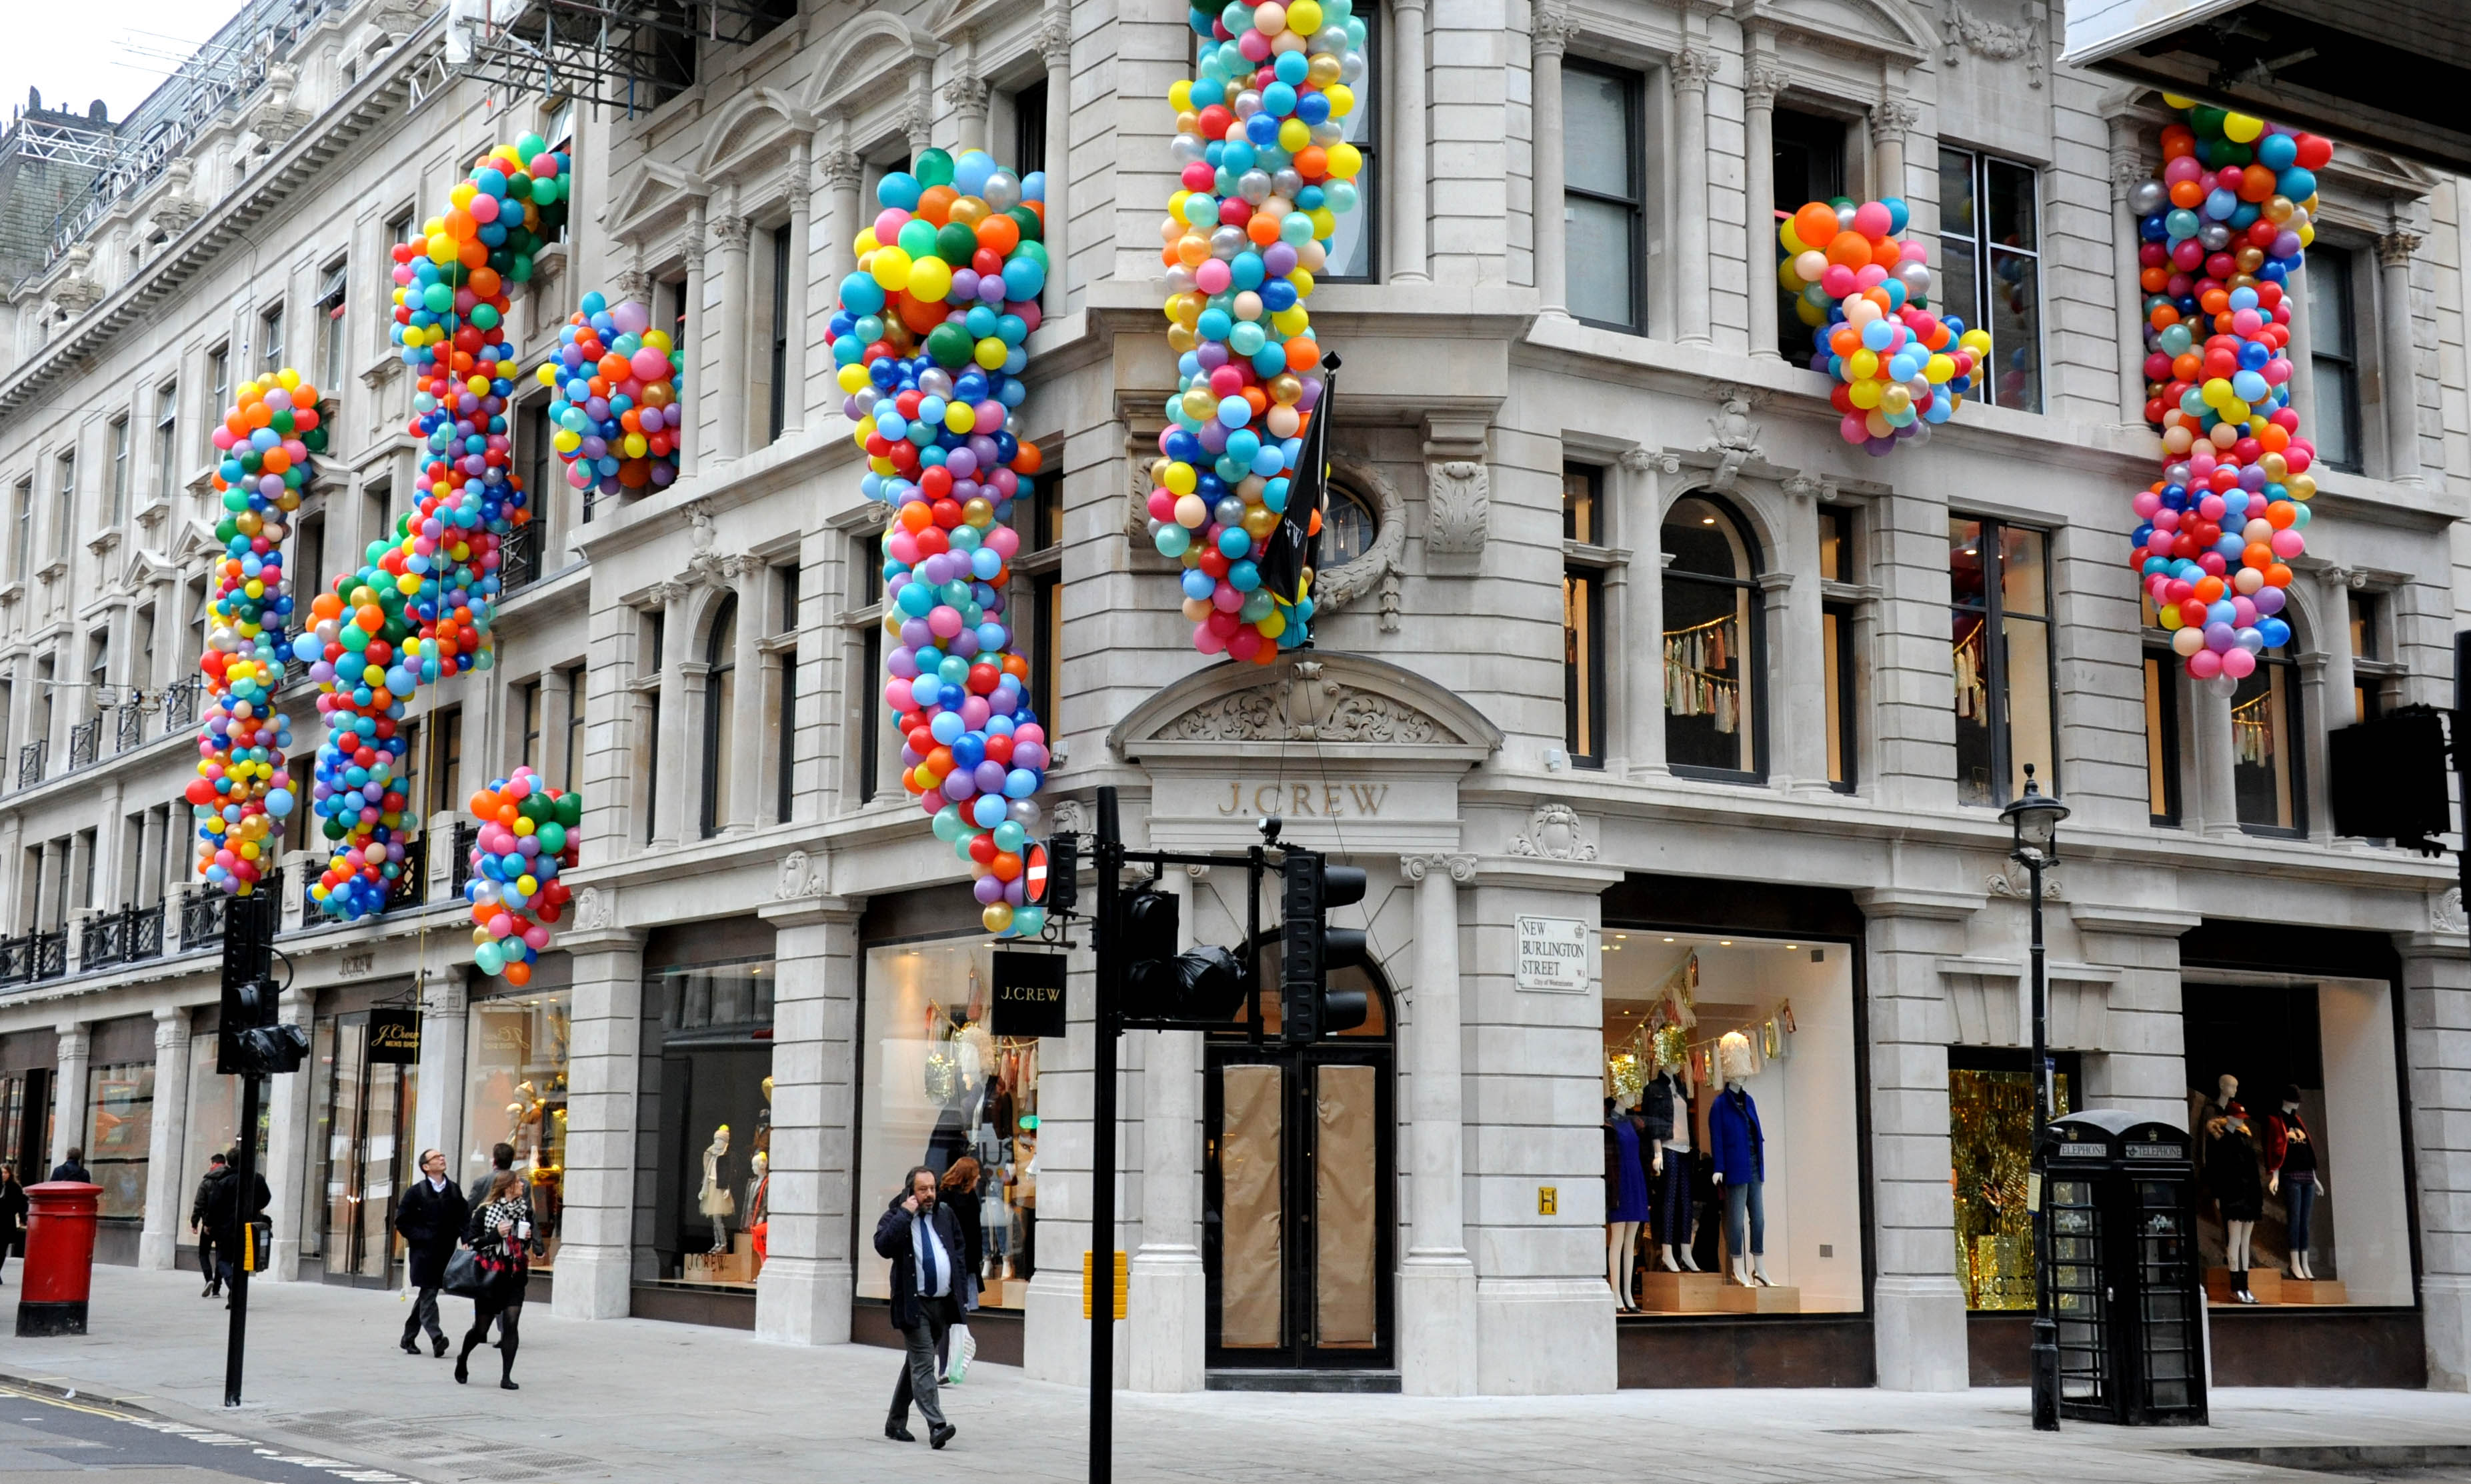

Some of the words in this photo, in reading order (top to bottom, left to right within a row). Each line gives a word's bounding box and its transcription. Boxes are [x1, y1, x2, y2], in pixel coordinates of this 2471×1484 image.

[1217, 783, 1389, 817] J.CREW
[1522, 921, 1546, 936] NEW
[1522, 941, 1584, 958] BURLINGTON
[1522, 960, 1560, 976] STREET
[1001, 987, 1060, 1001] J.CREW
[2061, 1144, 2107, 1157] ELEPHONE
[2138, 1146, 2182, 1157] TELEPHONE
